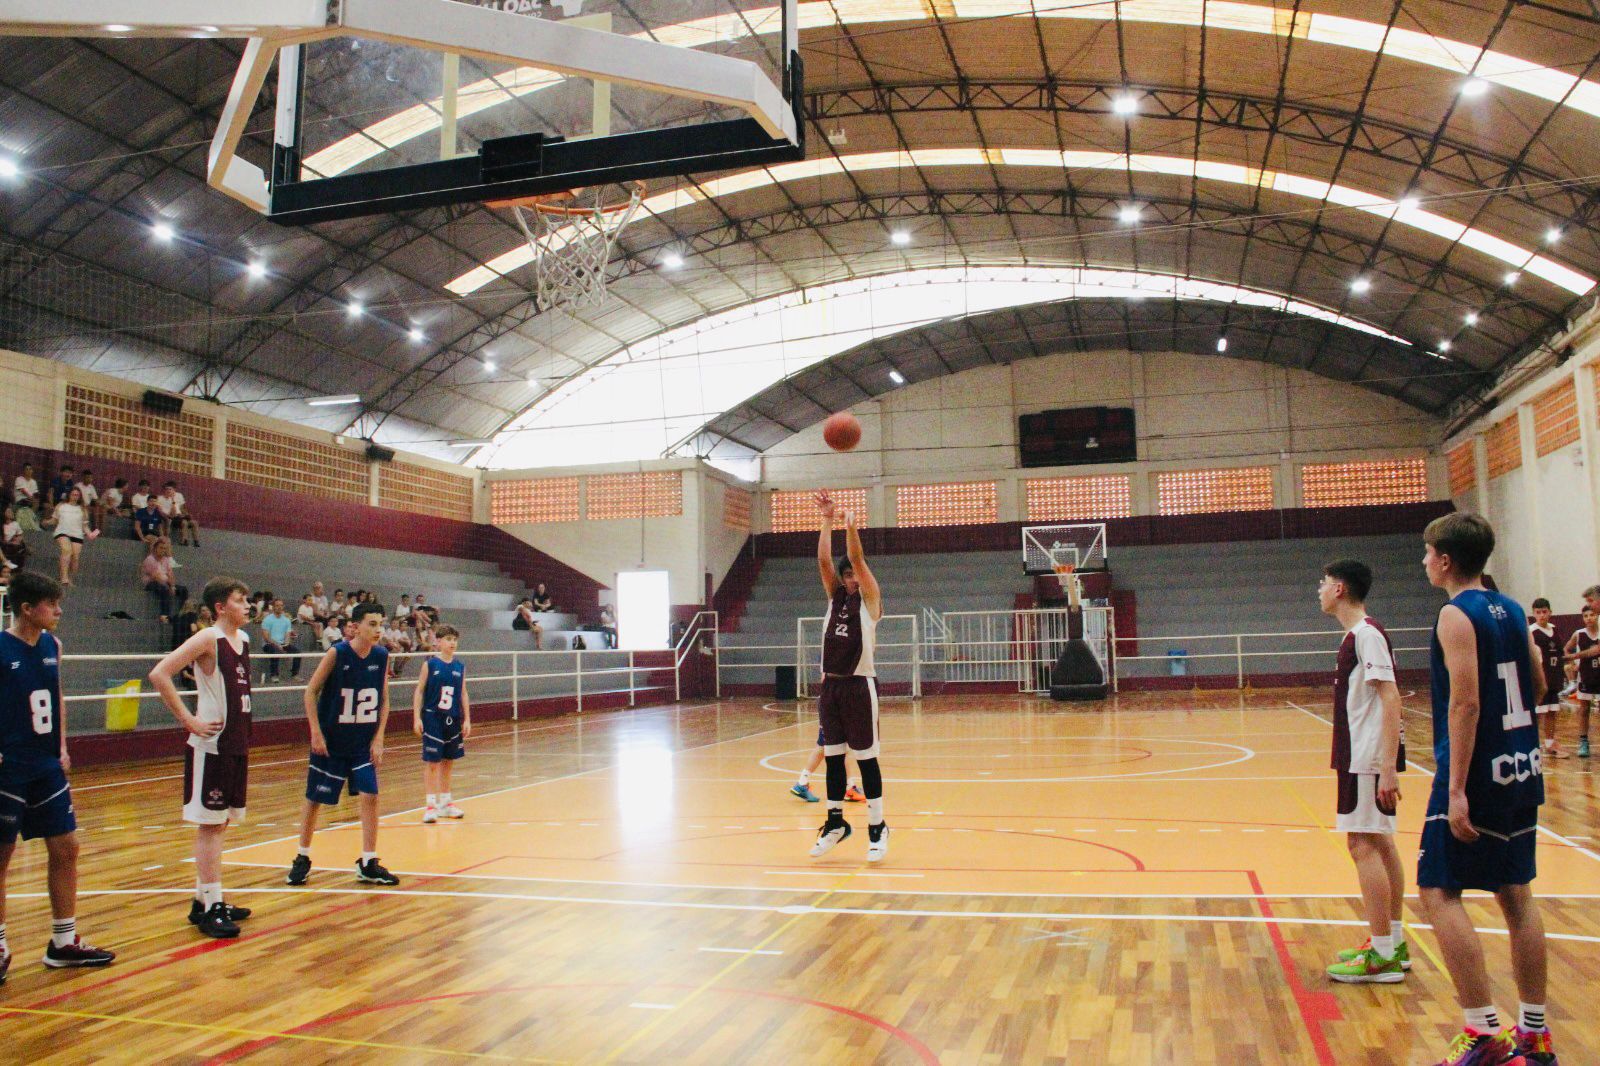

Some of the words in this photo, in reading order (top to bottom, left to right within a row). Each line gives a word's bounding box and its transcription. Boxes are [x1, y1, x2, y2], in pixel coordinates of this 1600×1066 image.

[30, 689, 53, 735] 8
[241, 694, 252, 713] 10
[339, 687, 379, 723] 12
[438, 685, 455, 710] 5
[1497, 661, 1533, 731] 1
